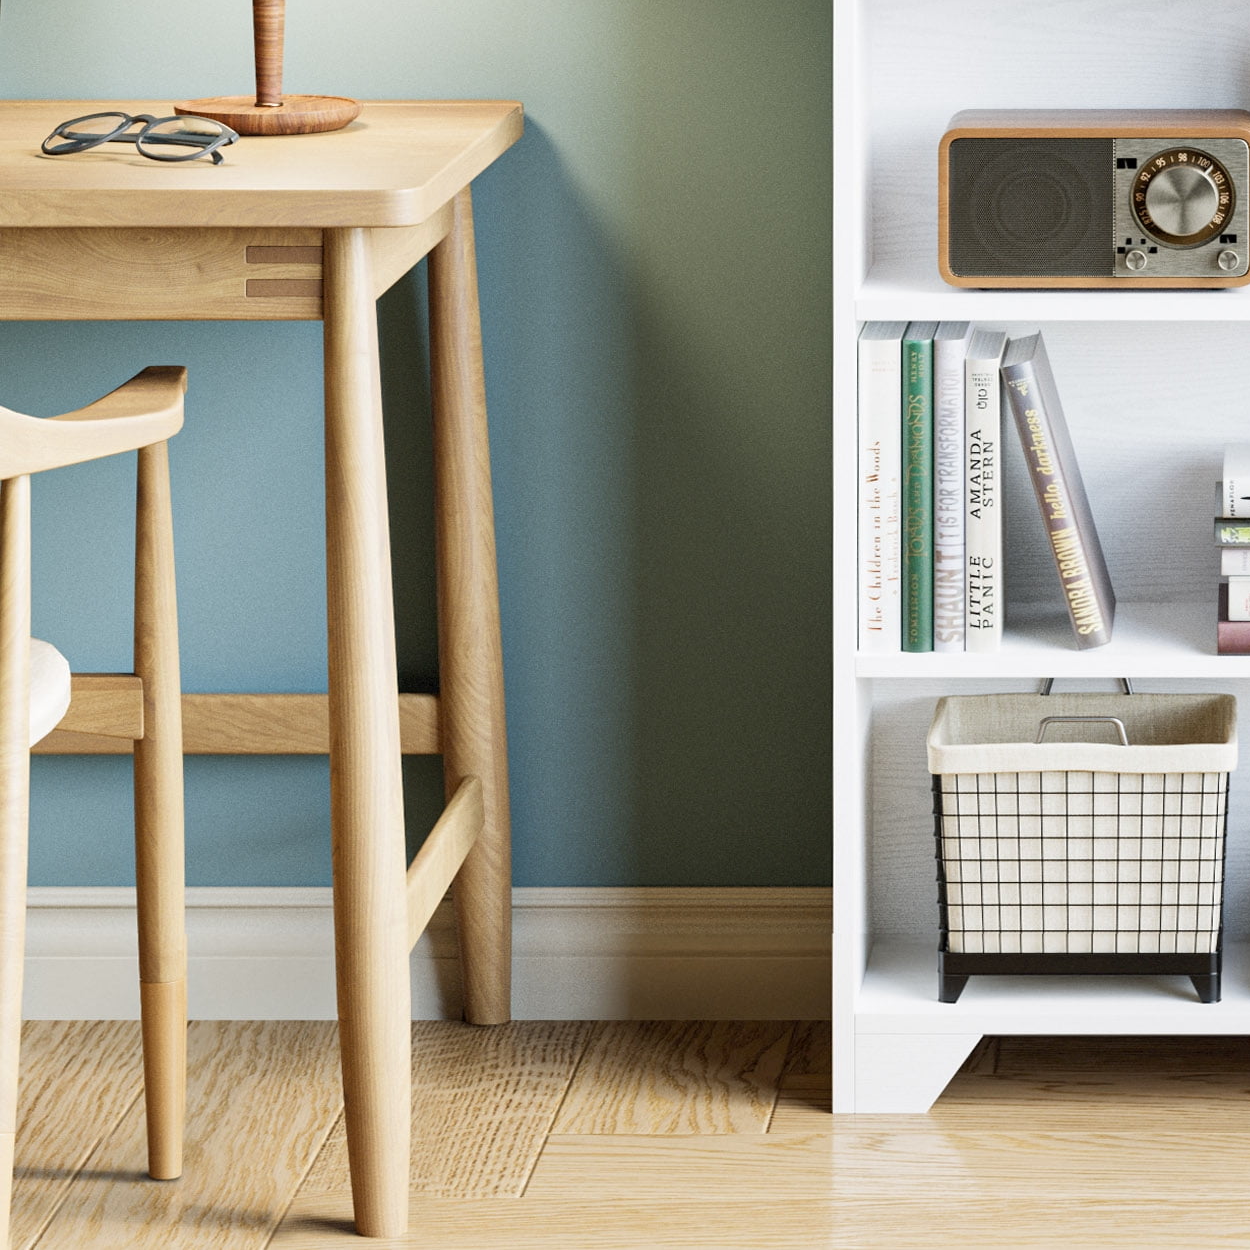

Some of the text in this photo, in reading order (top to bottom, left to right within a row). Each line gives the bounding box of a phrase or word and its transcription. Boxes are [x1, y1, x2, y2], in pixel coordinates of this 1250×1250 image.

[1140, 171, 1151, 182] 92
[1155, 157, 1166, 168] 95
[1178, 153, 1187, 162] 98
[1212, 171, 1225, 184] 103
[1220, 192, 1229, 205] 106
[969, 429, 982, 519] AMANDA
[983, 441, 994, 507] STERN
[1025, 409, 1067, 520] hello, darkness
[938, 516, 960, 528] IS
[939, 489, 960, 512] FOR
[866, 537, 882, 600] Children
[935, 550, 964, 643] SHAUN T
[969, 556, 981, 630] LITTLE
[983, 557, 994, 629] PANIC
[1050, 526, 1105, 636] SANDRA BROWN
